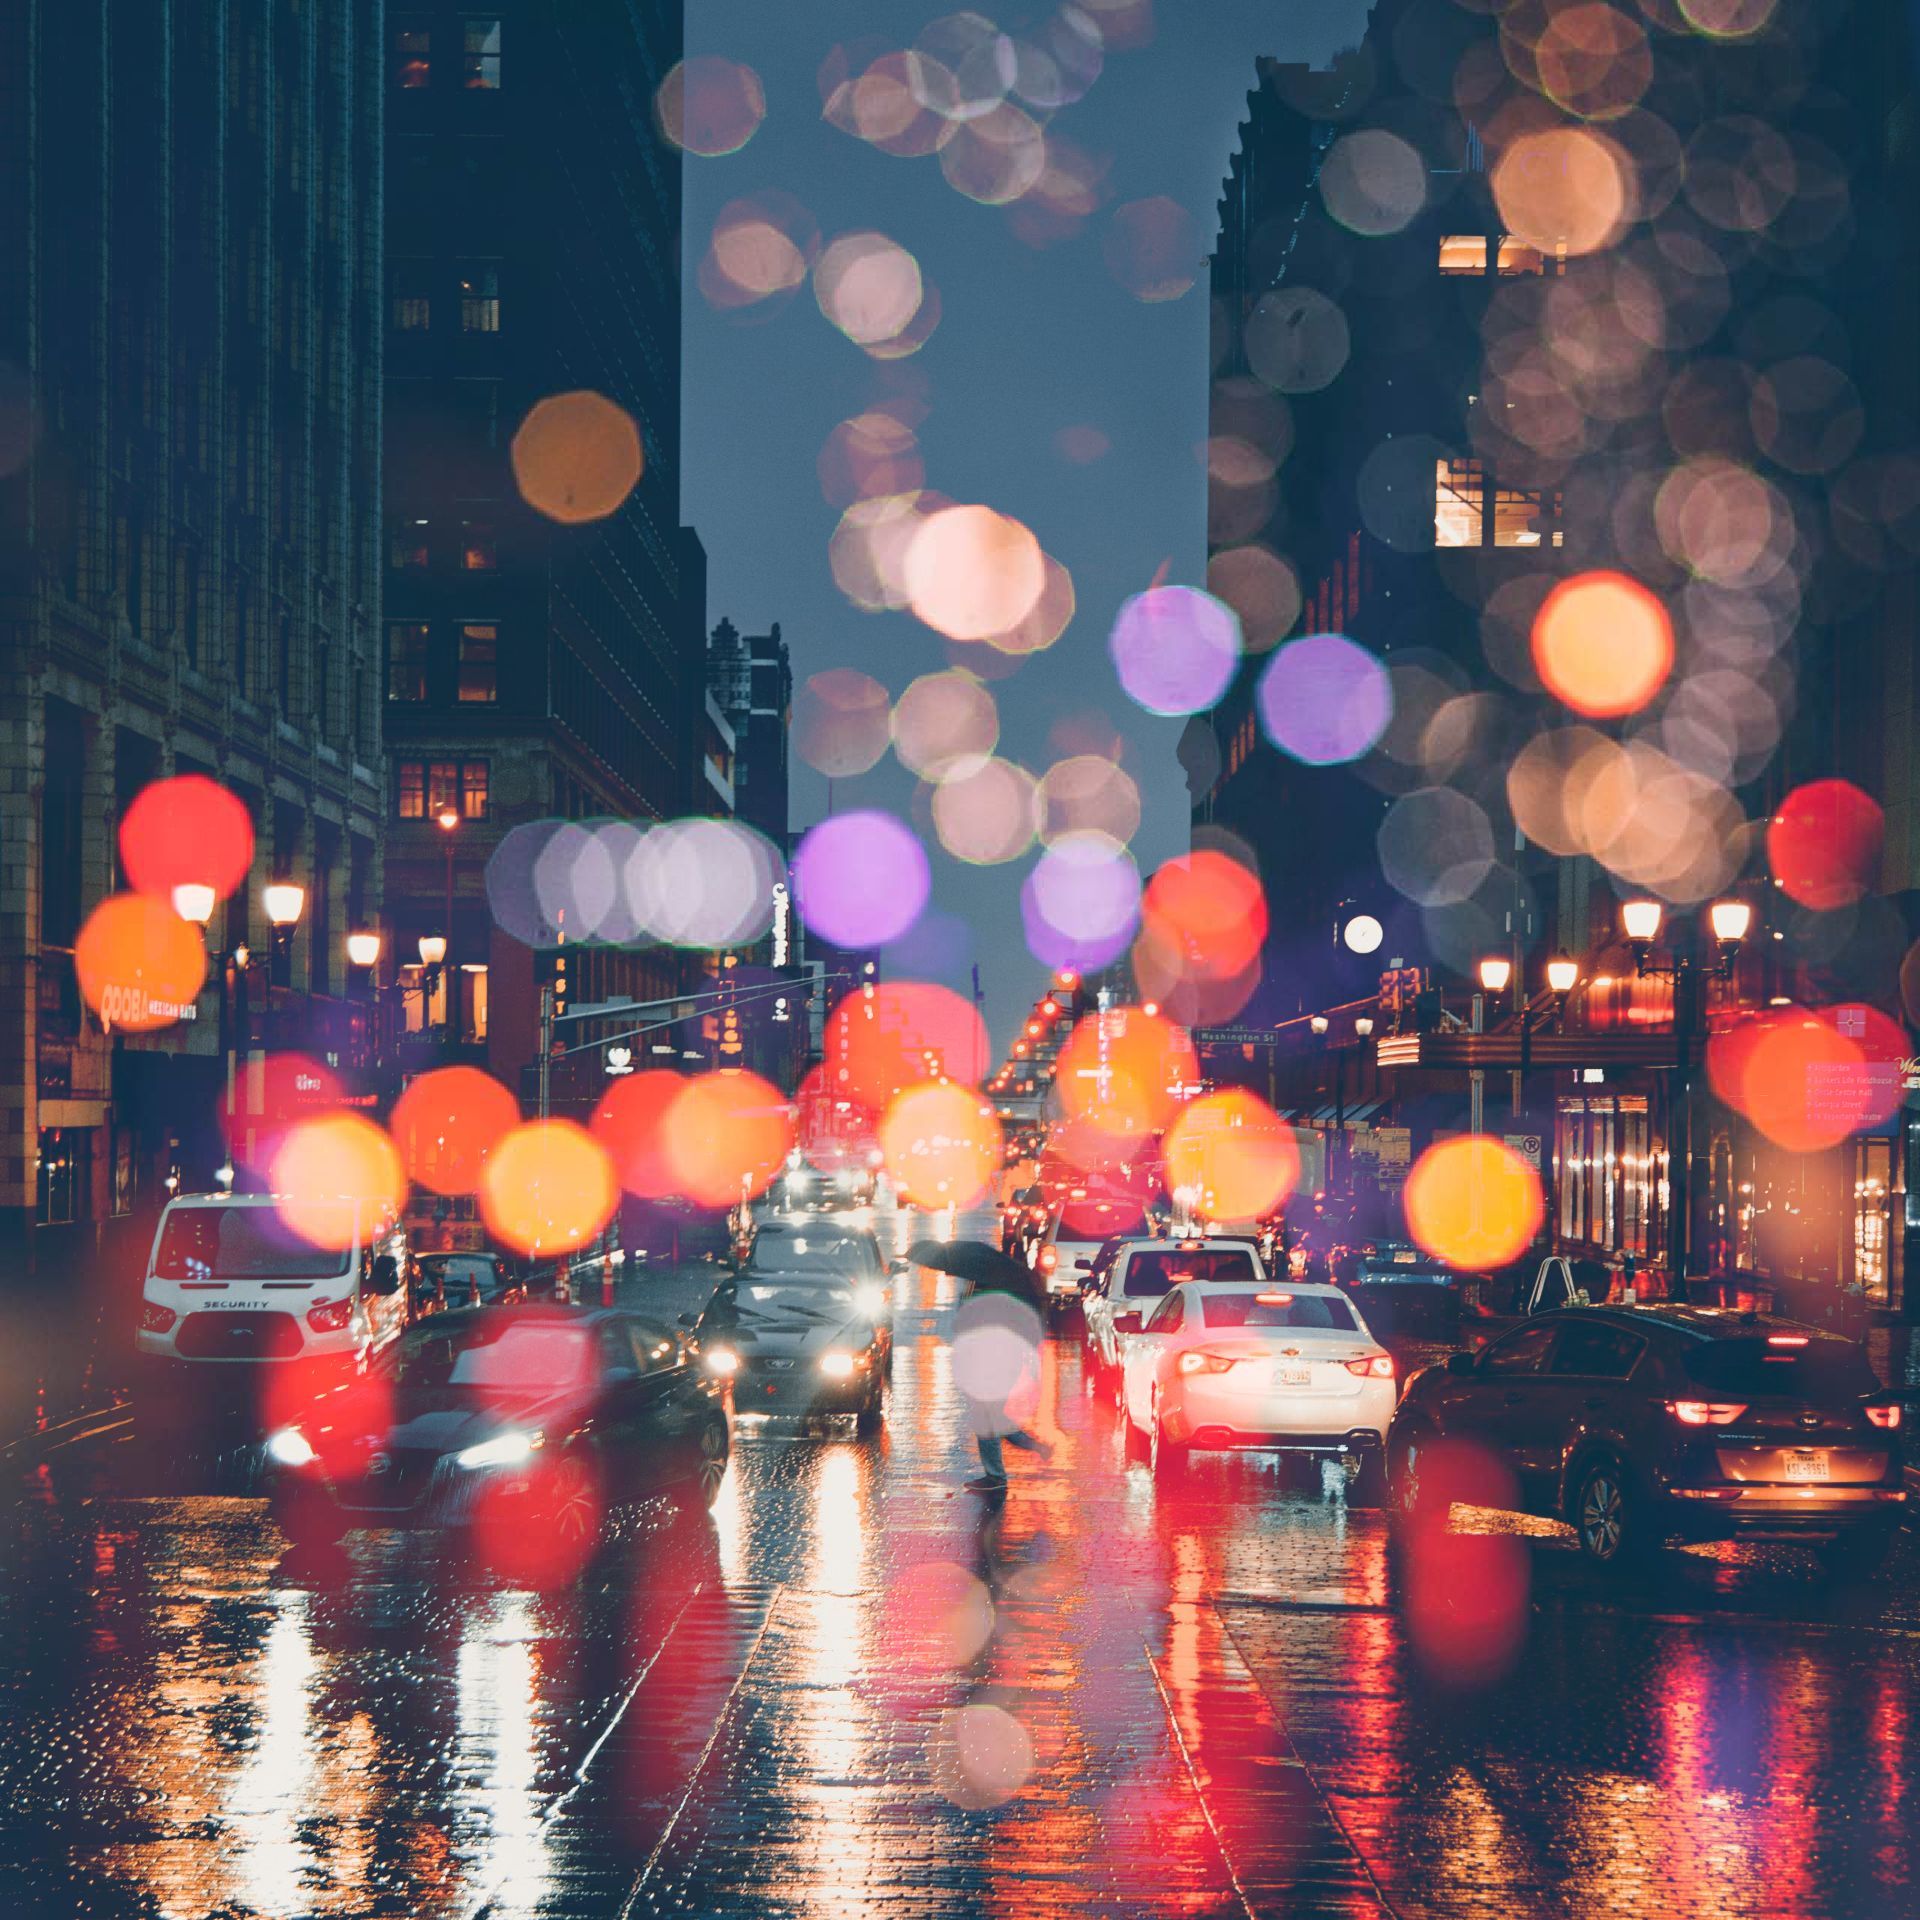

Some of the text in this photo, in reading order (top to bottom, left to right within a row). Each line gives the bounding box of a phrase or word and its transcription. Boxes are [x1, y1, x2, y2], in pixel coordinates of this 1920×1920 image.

[101, 984, 149, 1034] QDOBA
[1201, 1032, 1275, 1043] Washington St
[203, 1301, 270, 1309] SECURITY
